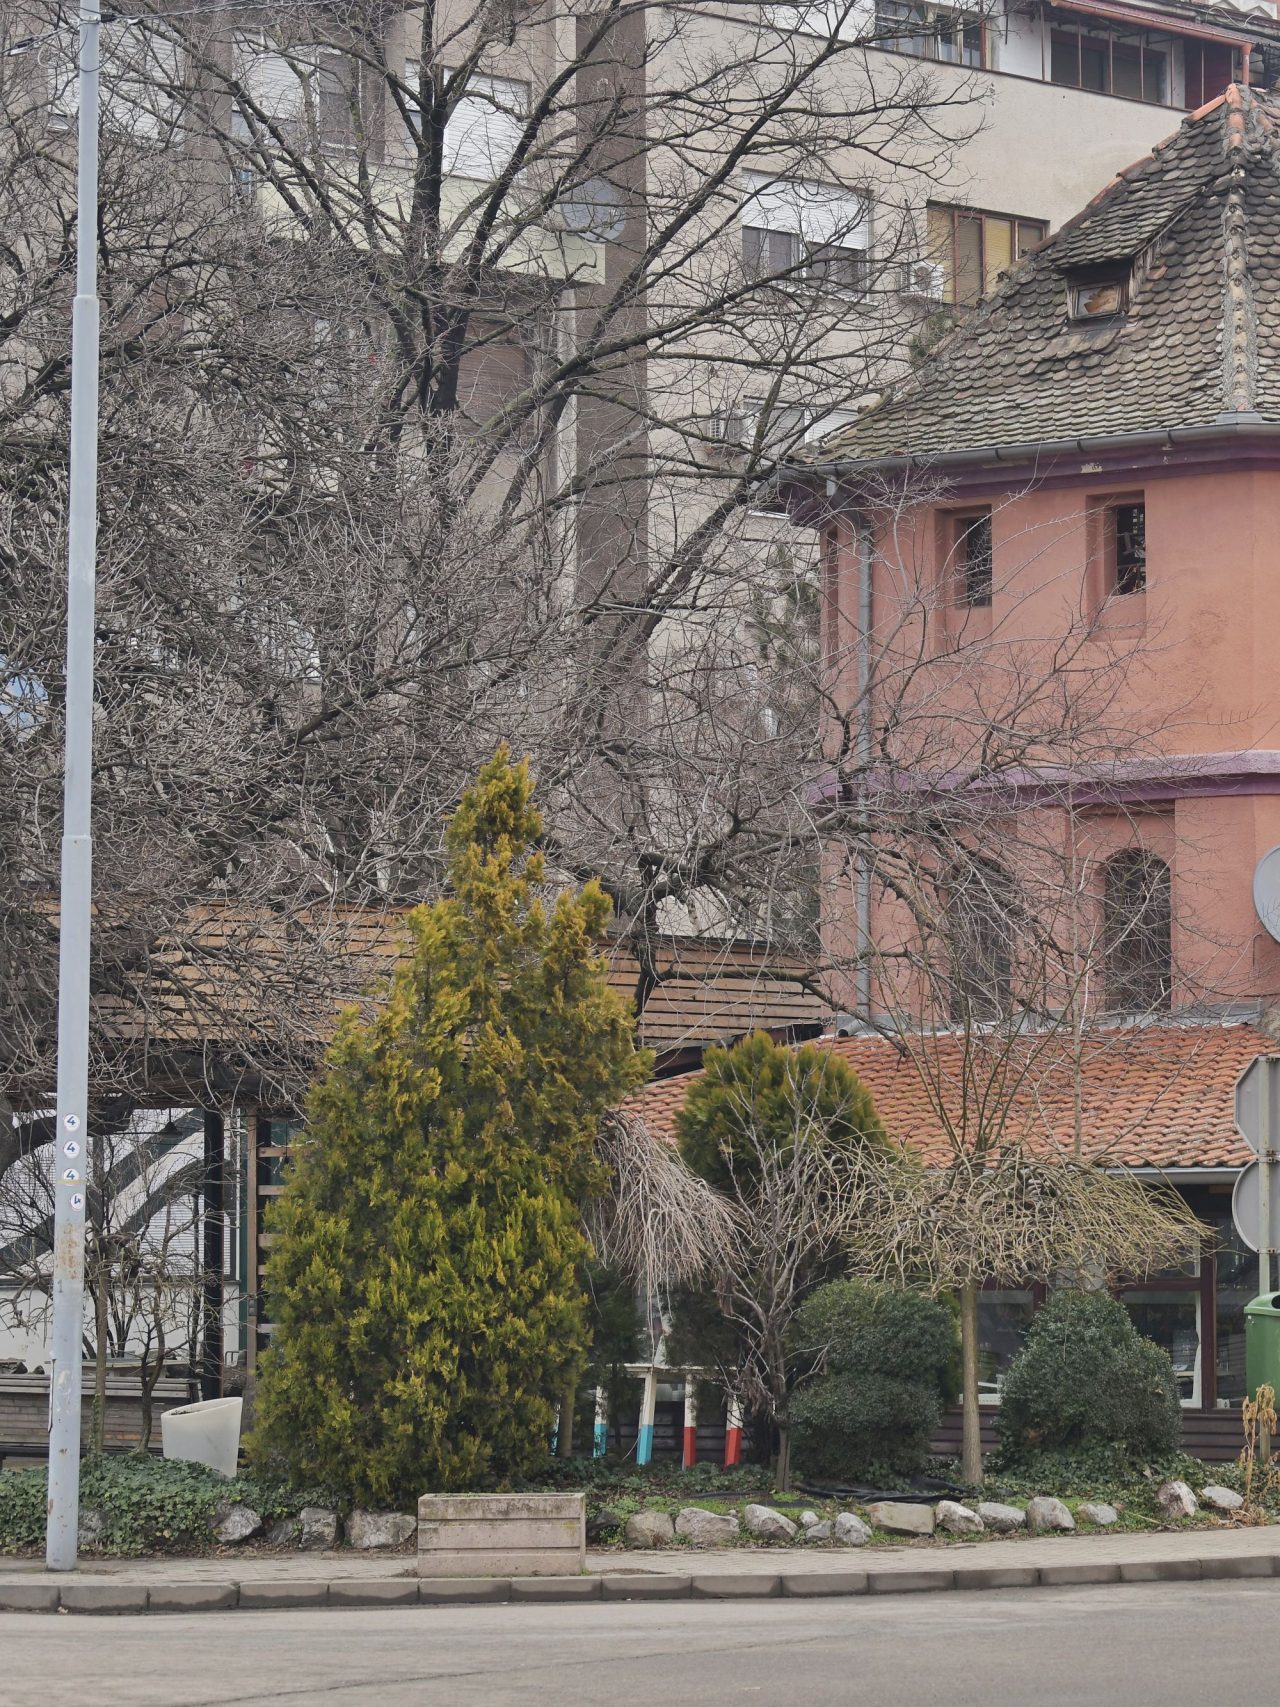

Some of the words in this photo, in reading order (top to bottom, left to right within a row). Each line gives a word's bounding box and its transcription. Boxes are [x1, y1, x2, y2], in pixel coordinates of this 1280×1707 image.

[66, 1116, 76, 1125] 4
[66, 1143, 76, 1152] 4
[66, 1170, 76, 1180] 4
